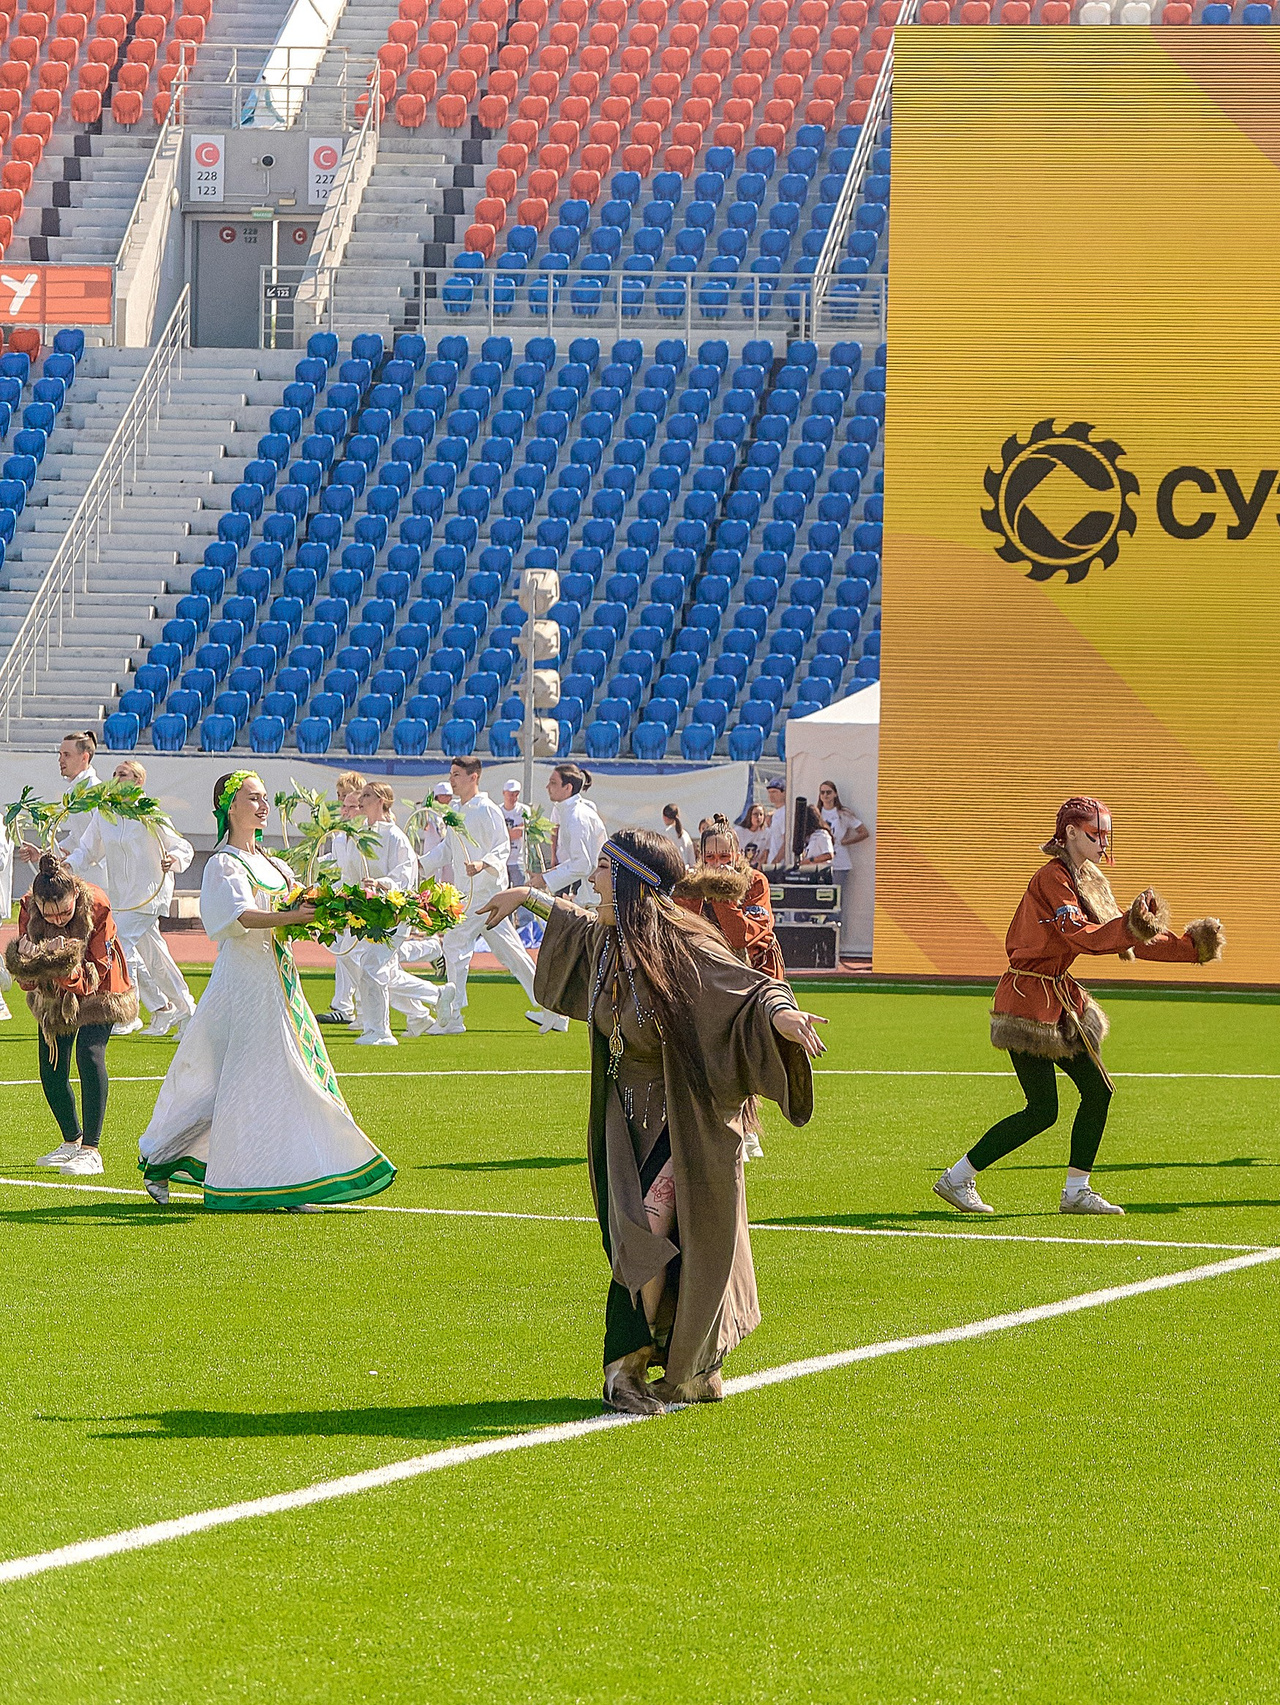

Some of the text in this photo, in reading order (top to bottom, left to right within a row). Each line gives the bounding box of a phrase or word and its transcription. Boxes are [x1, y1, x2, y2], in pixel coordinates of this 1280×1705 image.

[197, 171, 218, 181] 228
[315, 174, 335, 184] 227
[197, 186, 217, 196] 123
[315, 189, 331, 199] 12
